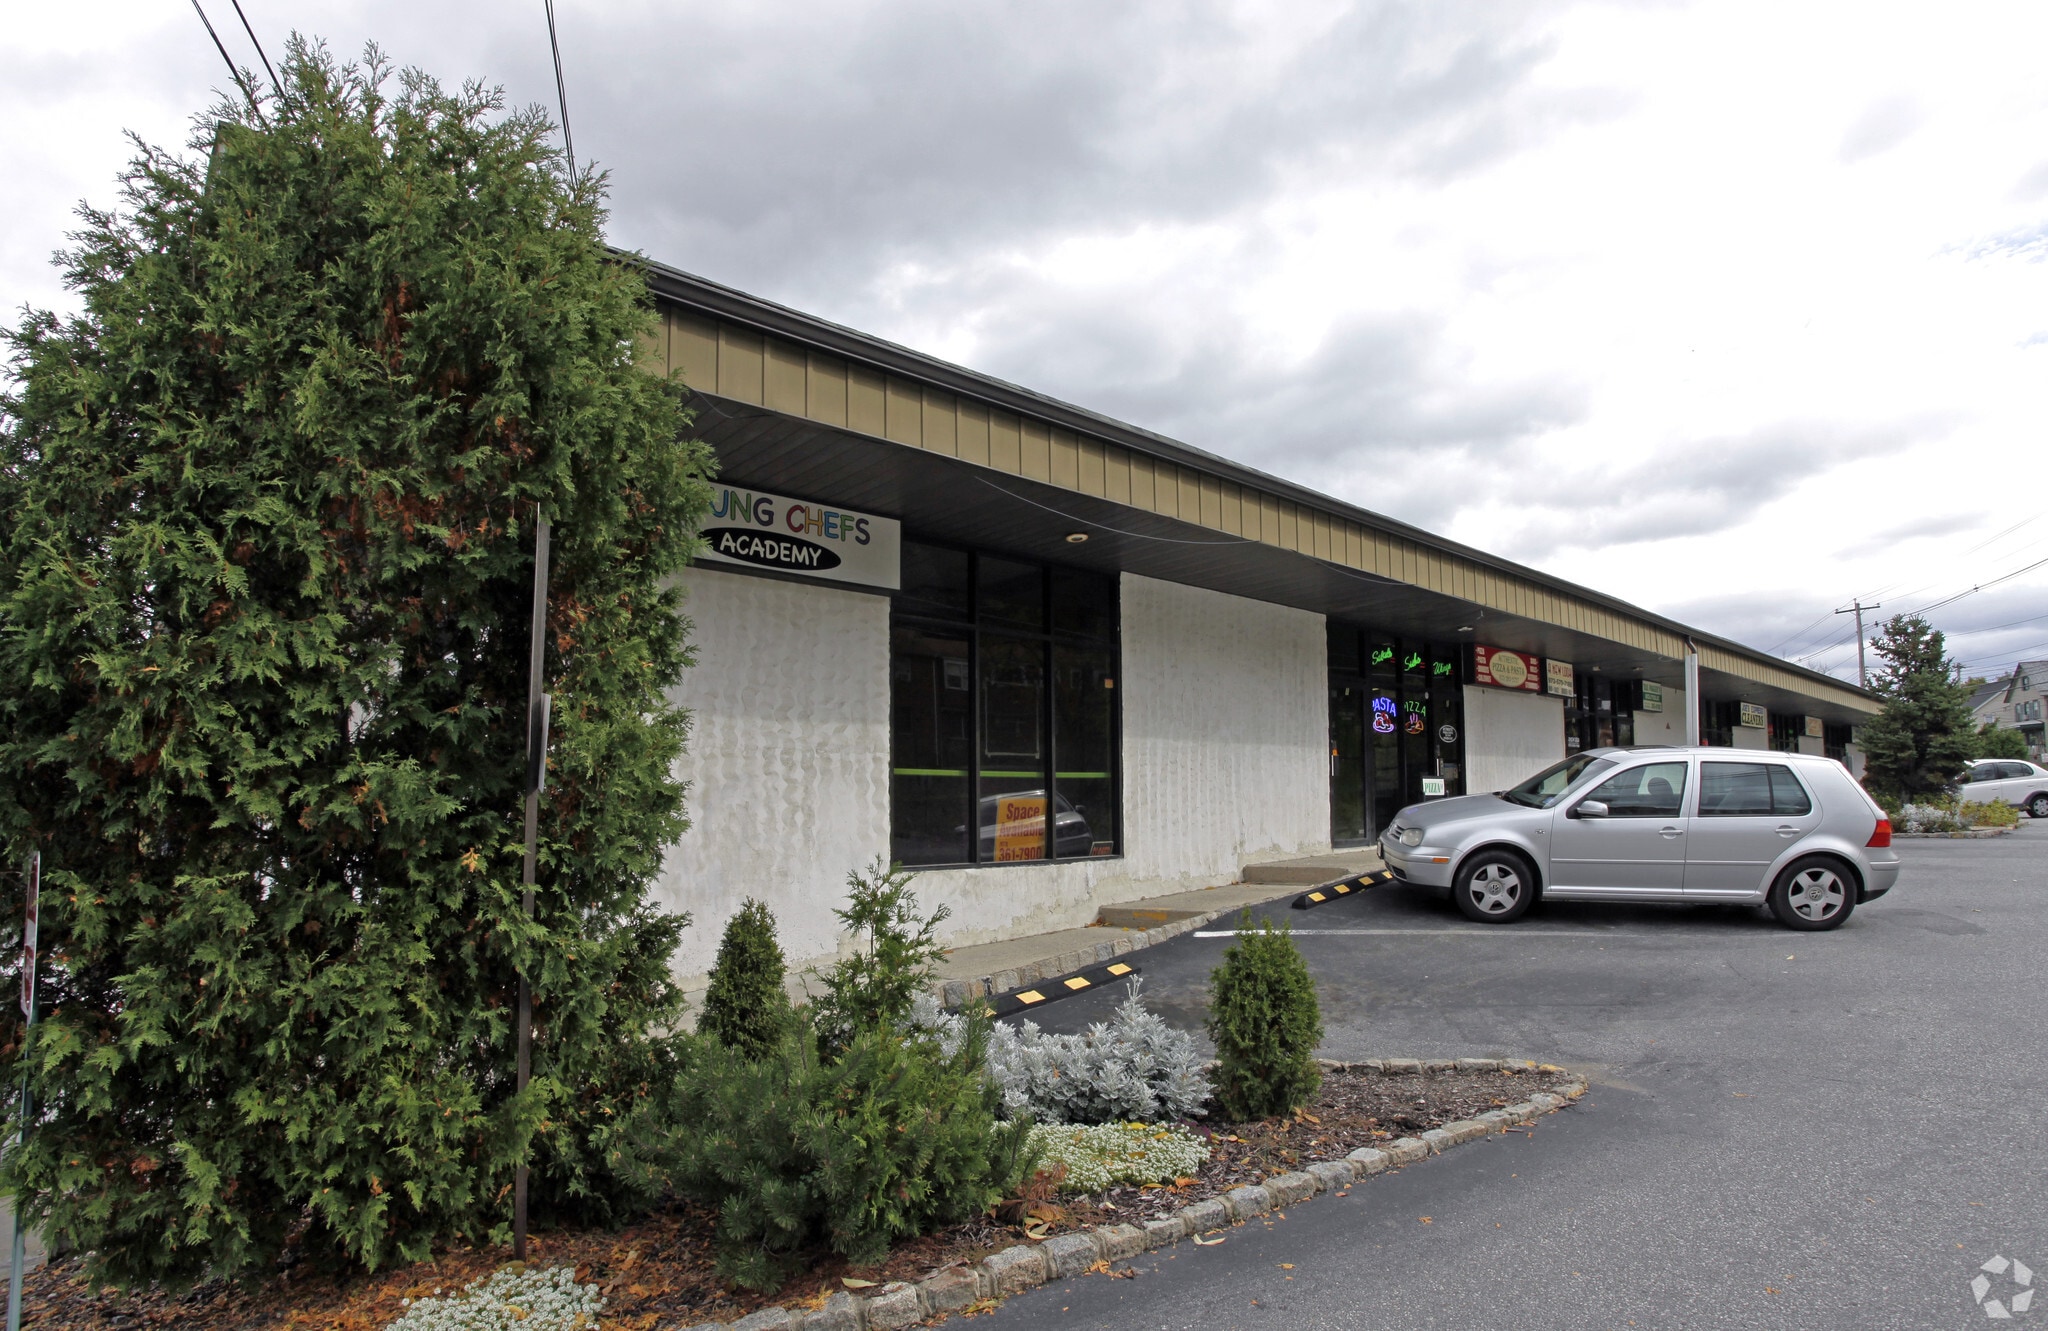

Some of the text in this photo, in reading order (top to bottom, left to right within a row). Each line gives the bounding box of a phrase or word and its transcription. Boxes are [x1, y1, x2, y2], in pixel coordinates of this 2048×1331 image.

[709, 487, 871, 546] UNG CHEFS
[719, 532, 822, 567] ACADEMY
[1404, 701, 1427, 717] IZZA
[1742, 712, 1764, 726] CLEANERS
[1424, 782, 1441, 793] PIZZA
[1006, 803, 1040, 821] Space
[1000, 821, 1045, 837] Available
[999, 847, 1042, 861] 361-7900
